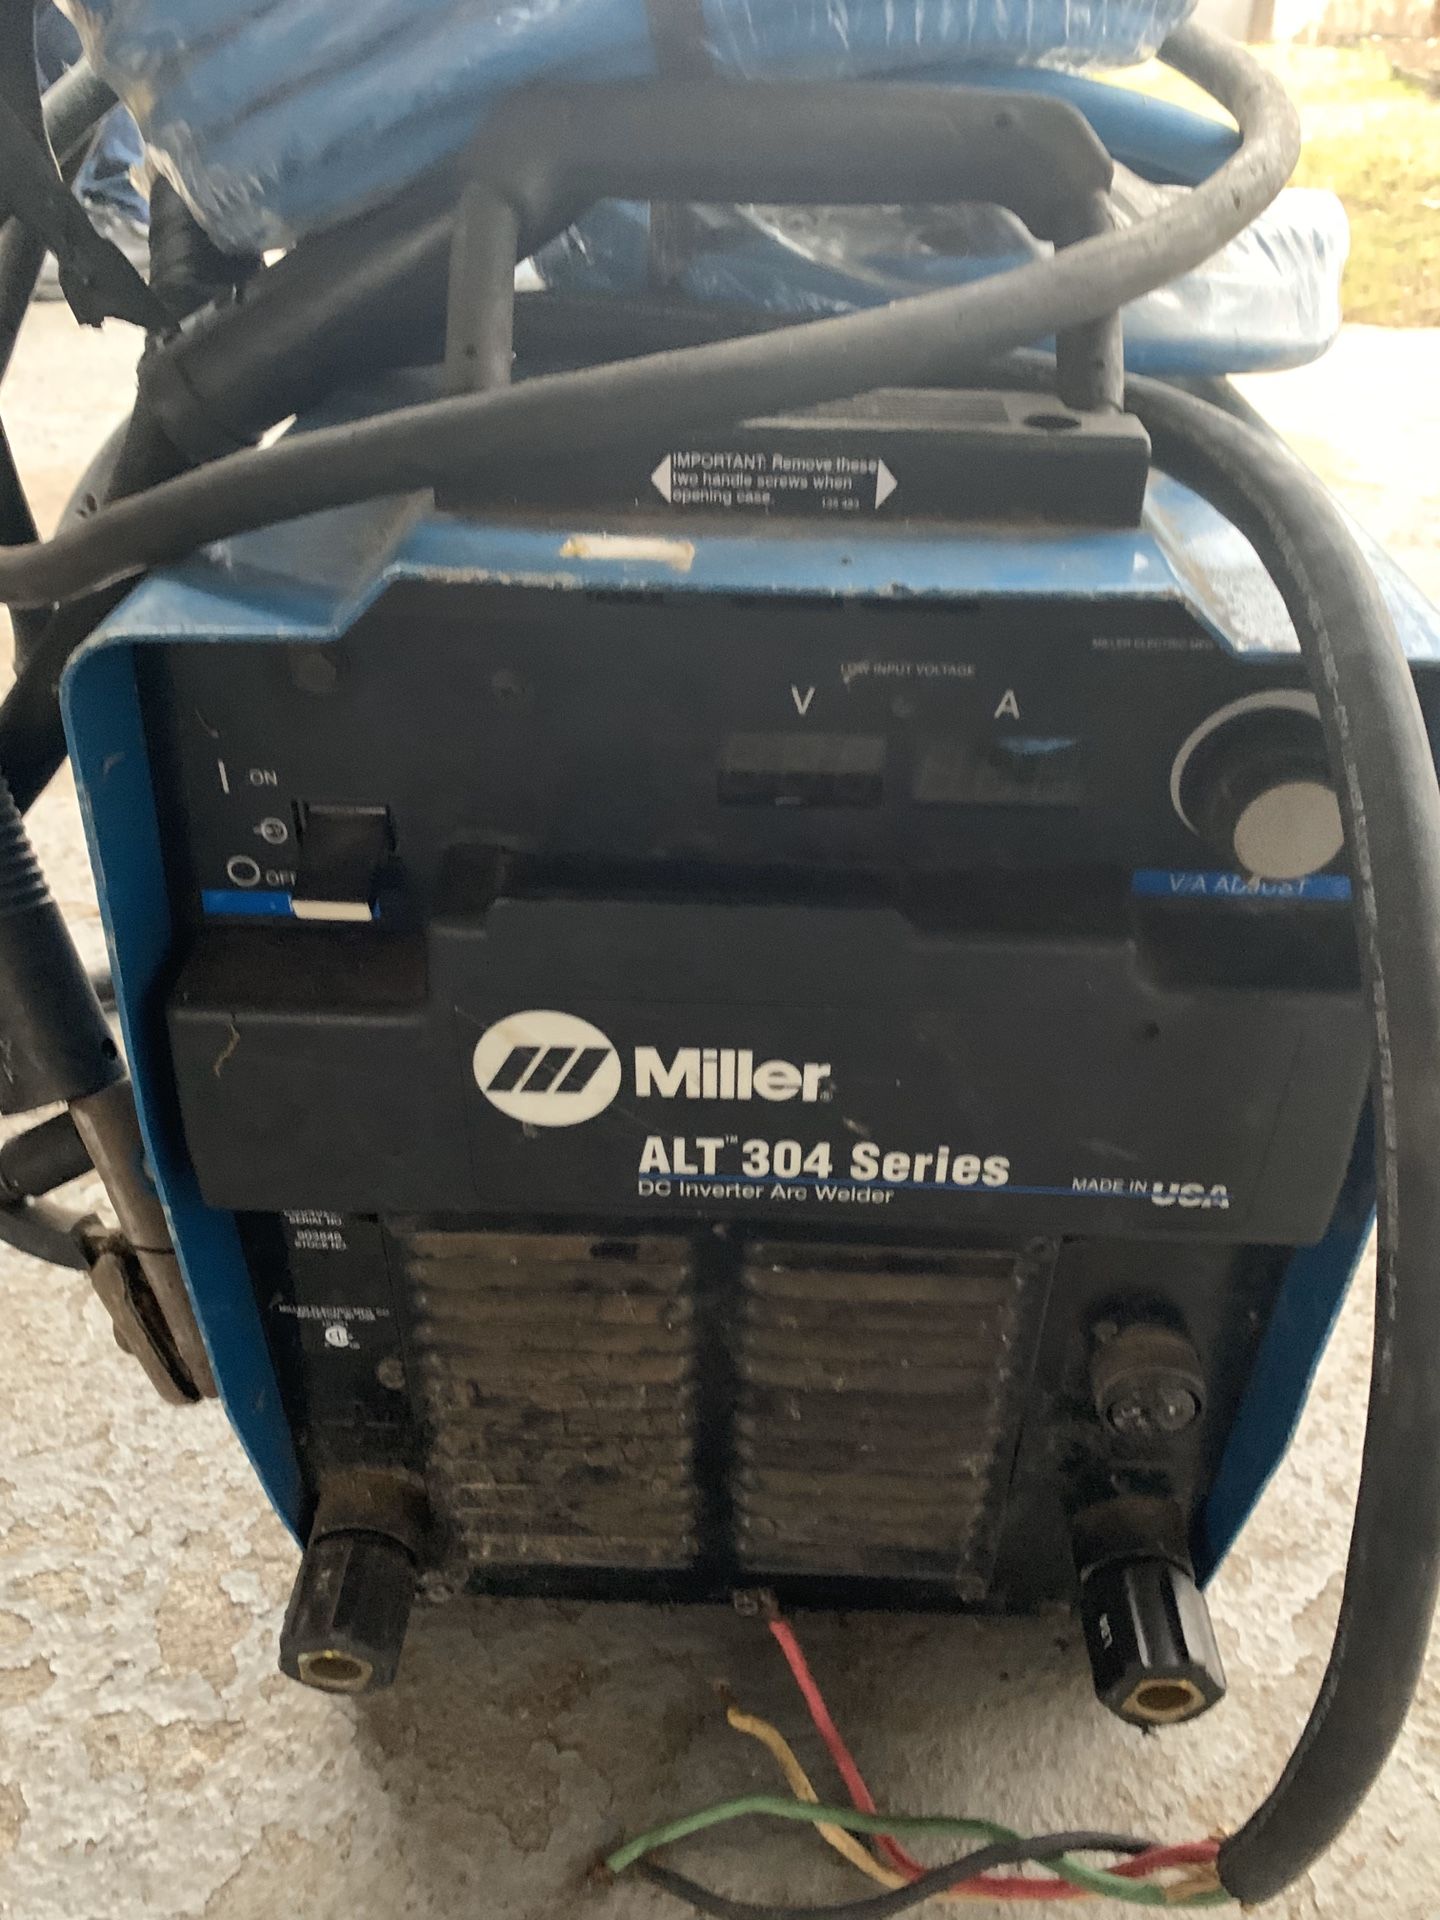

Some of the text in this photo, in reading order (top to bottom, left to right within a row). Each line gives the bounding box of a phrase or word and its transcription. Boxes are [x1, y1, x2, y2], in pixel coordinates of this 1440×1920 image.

[771, 453, 833, 472] Remove
[835, 455, 878, 474] these
[672, 471, 853, 490] two handle screws when
[672, 489, 732, 506] opening
[873, 662, 912, 676] INPUT
[915, 663, 976, 677] VOLTAGE
[791, 685, 816, 716] V
[994, 688, 1020, 720] A
[250, 769, 278, 786] ON
[634, 1046, 832, 1102] Miller
[742, 1139, 834, 1179] 304
[849, 1142, 1011, 1187] Series
[638, 1180, 895, 1204] DC Inverter Arc Welder
[1072, 1177, 1230, 1210] MADE IN USA
